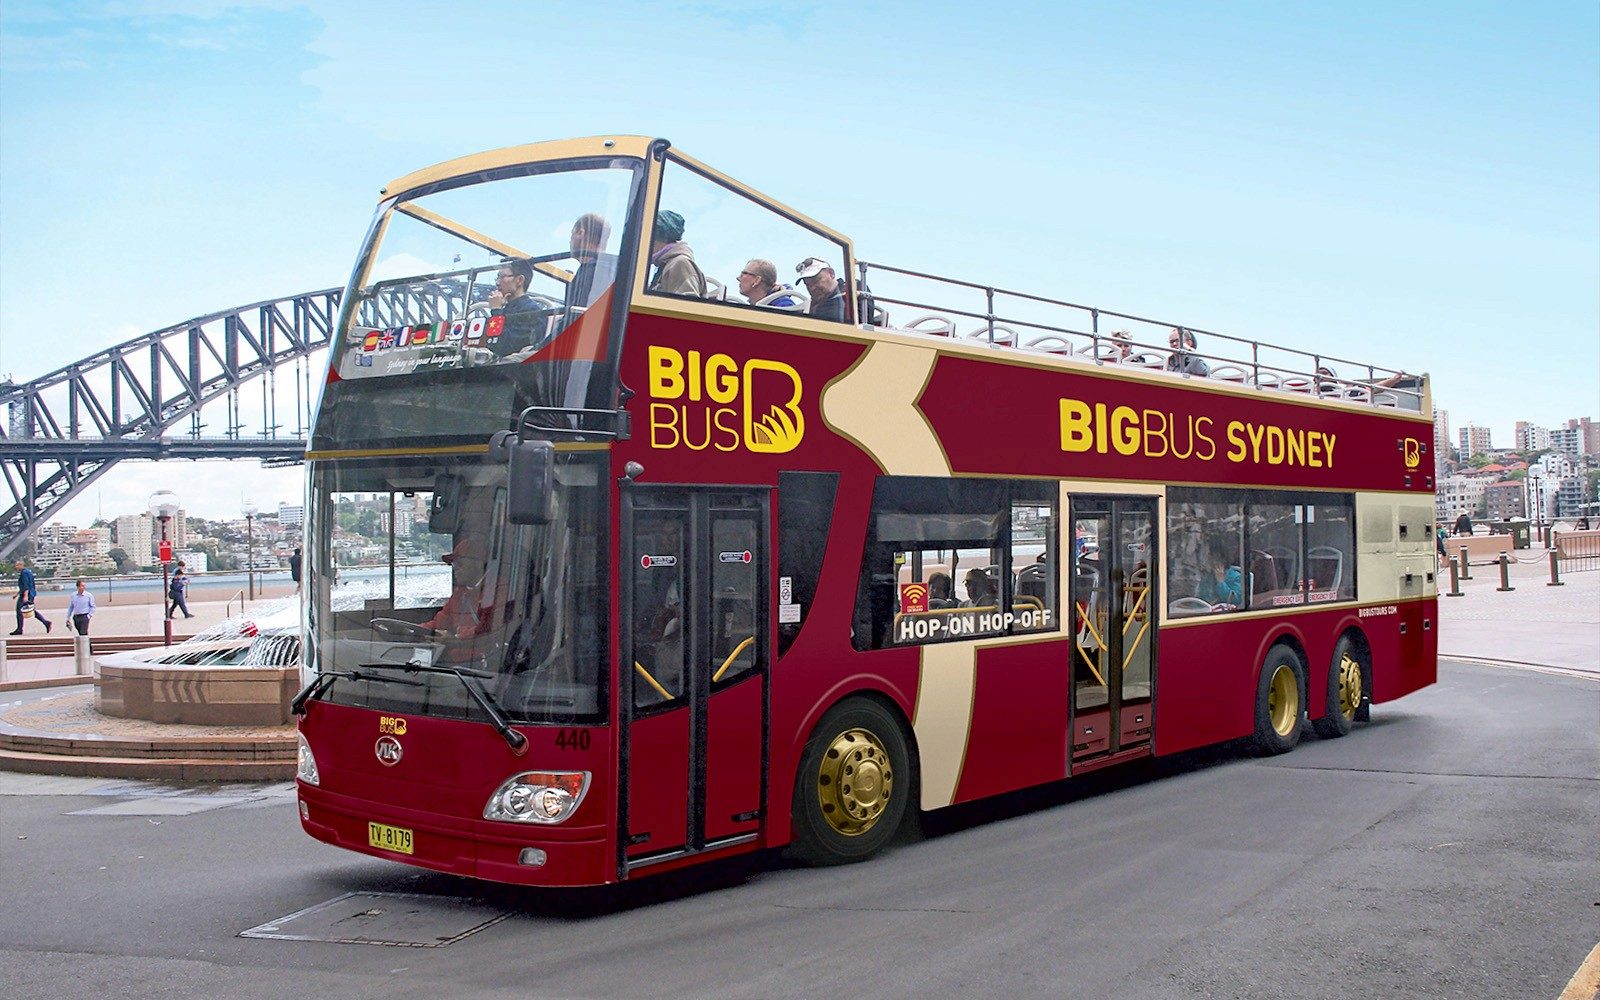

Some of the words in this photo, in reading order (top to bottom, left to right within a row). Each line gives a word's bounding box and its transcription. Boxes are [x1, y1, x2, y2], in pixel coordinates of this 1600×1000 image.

[430, 353, 463, 368] language
[648, 345, 739, 404] BIG
[650, 402, 740, 452] BUS
[1226, 420, 1336, 469] SYDNEY
[1358, 605, 1398, 618] BIGBUSTOURSCOM
[901, 615, 975, 640] HOP-ON
[979, 608, 1052, 632] HOP-OFF
[379, 724, 395, 734] BUS
[380, 716, 395, 726] BIG
[554, 729, 591, 751] 440
[370, 824, 411, 848] TV-8179
